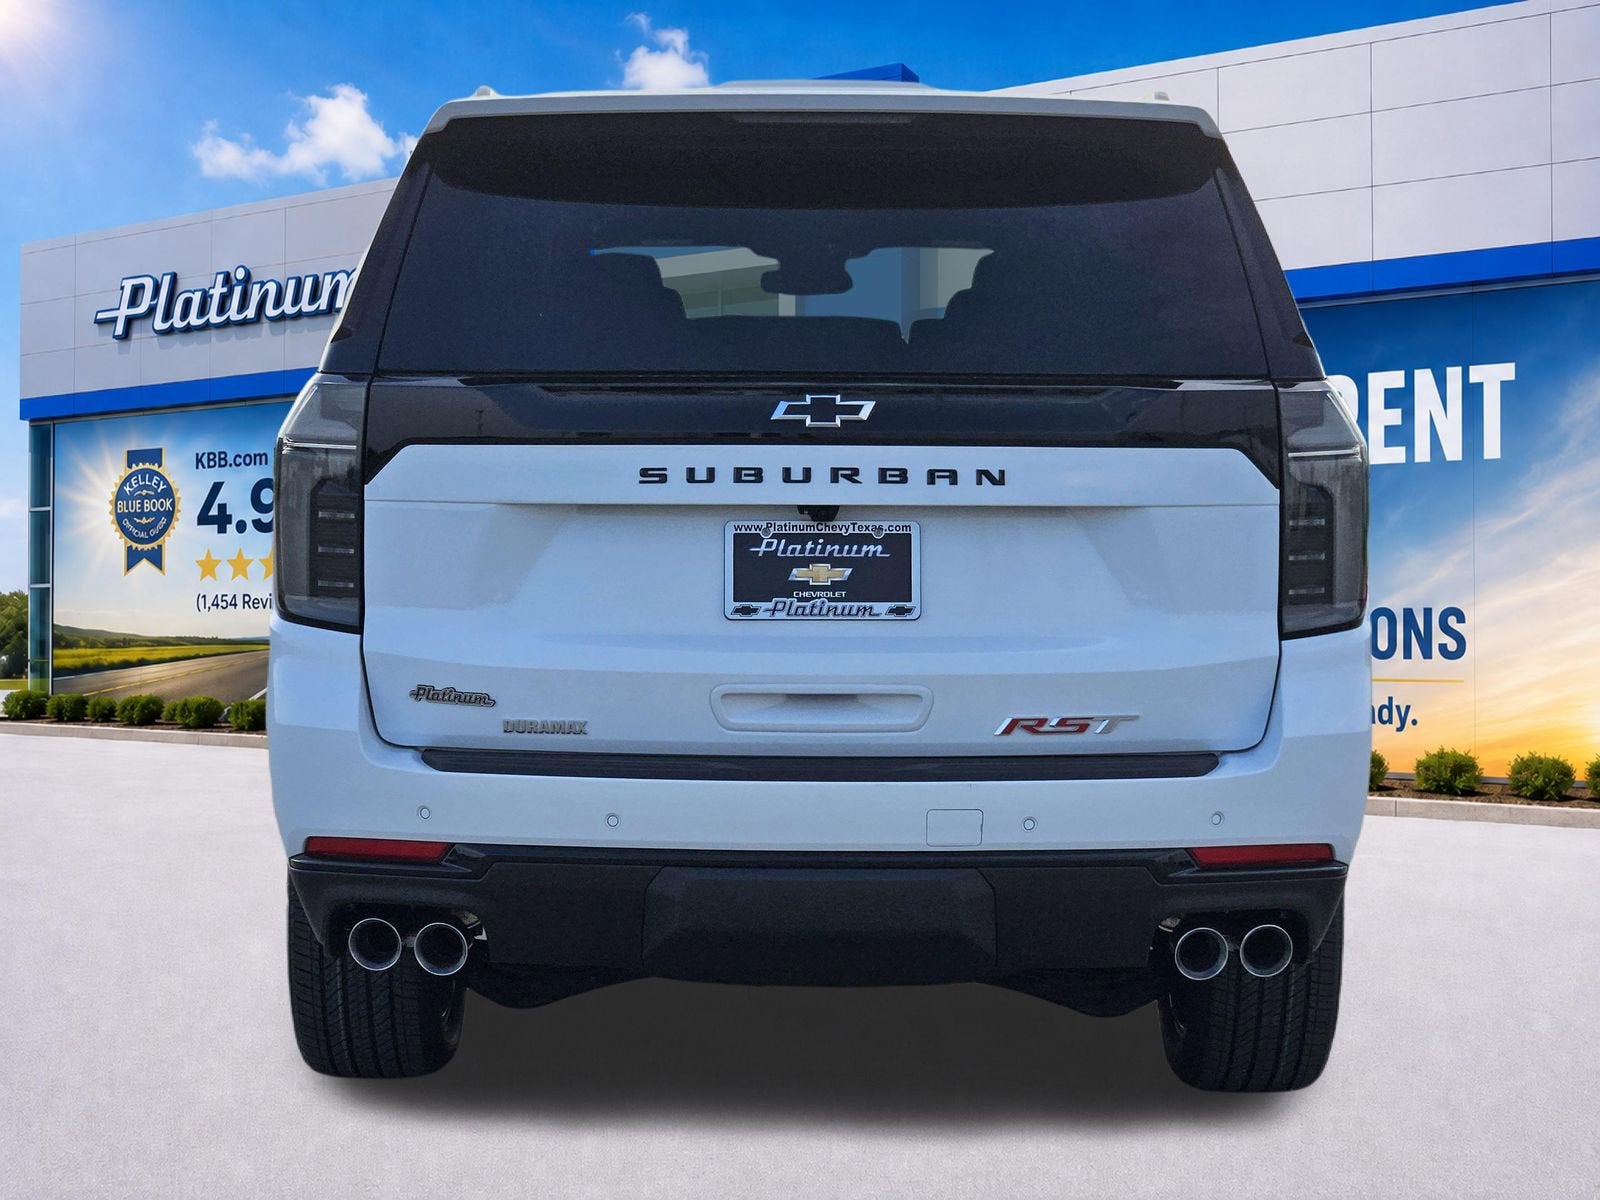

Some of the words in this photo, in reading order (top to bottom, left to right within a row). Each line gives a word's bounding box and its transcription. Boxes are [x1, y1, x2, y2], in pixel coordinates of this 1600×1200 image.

[195, 451, 268, 470] KBB.com
[123, 473, 167, 496] KELLEY
[638, 466, 1006, 486] SUBURBAN
[117, 500, 142, 513] BLUE
[143, 498, 173, 512] BOOK
[196, 477, 273, 535] 4.9
[750, 538, 890, 557] Platinum
[196, 594, 238, 612] (1,454
[762, 599, 882, 618] Platinum
[409, 684, 496, 707] Platinum
[503, 719, 588, 735] DURAMAX
[993, 714, 1140, 736] RST
